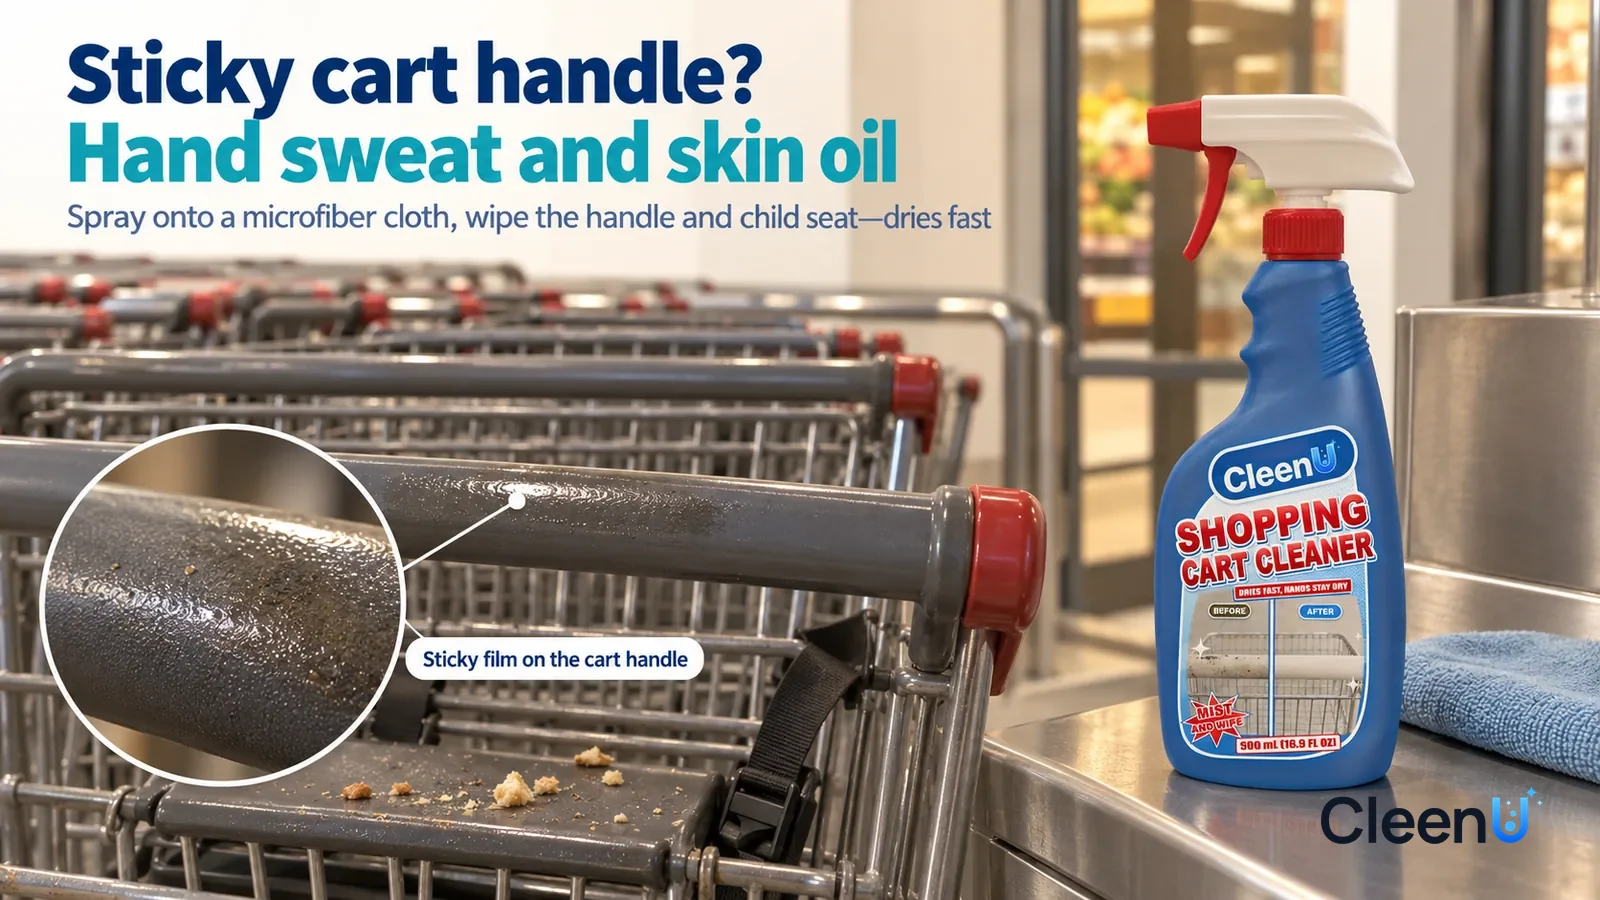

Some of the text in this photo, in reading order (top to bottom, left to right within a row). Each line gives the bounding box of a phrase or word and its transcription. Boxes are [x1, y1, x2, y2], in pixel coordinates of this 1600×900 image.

[1223, 443, 1338, 493] CleenU
[1177, 493, 1368, 554] SHOPPING
[1181, 531, 1375, 587] CART CLEANER
[1312, 583, 1331, 592] STAY
[1307, 608, 1335, 616] AFTER
[1196, 703, 1233, 720] MIST
[1191, 722, 1214, 734] AND
[1263, 740, 1278, 750] mL
[1308, 738, 1319, 748] FL
